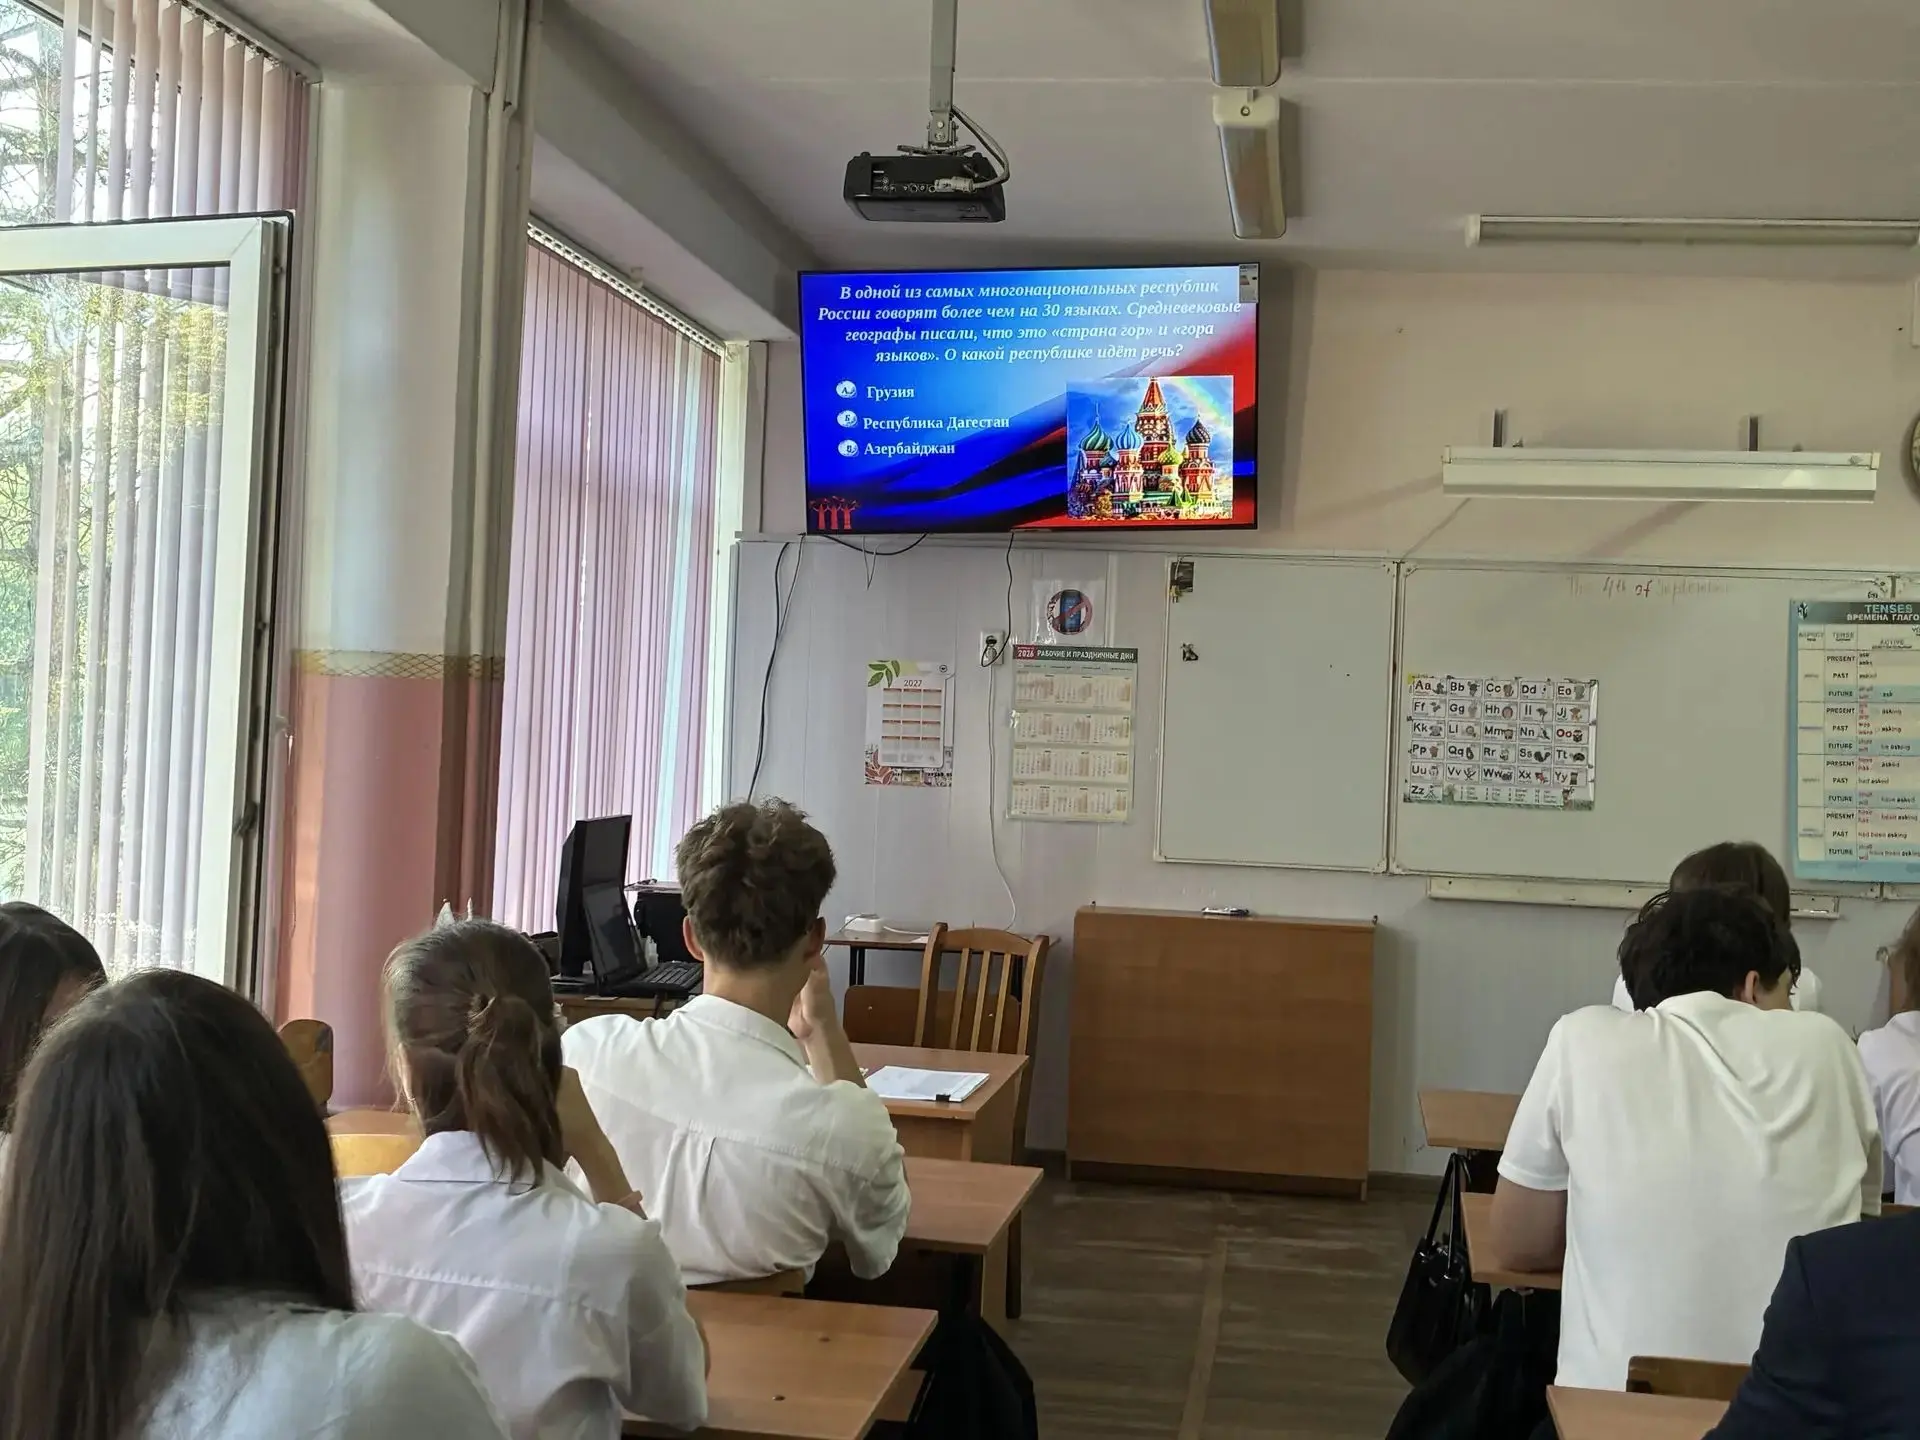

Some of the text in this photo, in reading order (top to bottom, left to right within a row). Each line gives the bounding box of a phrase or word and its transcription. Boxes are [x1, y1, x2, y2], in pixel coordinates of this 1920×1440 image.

[840, 279, 1219, 299] В одной из самых многонациональных республик
[818, 301, 1241, 322] России говорят более чем на 30 языках. Средневековые
[845, 324, 1214, 344] географы писали, что это «страна гор» и «гора
[875, 343, 1184, 363] языков». О какой республике идёт речь?
[867, 386, 915, 401] Грузия
[863, 416, 943, 432] Республика
[947, 416, 1010, 431] Дагестан
[864, 442, 955, 457] Азербайджан
[1635, 580, 1653, 598] of
[1864, 604, 1913, 614] TENSES
[1072, 651, 1119, 659] ПРАЗДНИЧНЫЕ
[1120, 652, 1134, 660] ДНИ
[1415, 680, 1431, 690] Aa
[1450, 681, 1465, 691] Bb
[1486, 683, 1501, 693] Cc
[1522, 684, 1536, 694] Dd
[1414, 702, 1426, 711] Ff
[1450, 703, 1465, 714] Gg
[1485, 704, 1500, 714] Hh
[1413, 723, 1428, 732] Kk
[1520, 727, 1535, 736] Nn
[1557, 729, 1572, 738] Oo
[1413, 744, 1567, 759] Pp Qq Rr Ss Tt
[1412, 765, 1427, 774] Uu
[1447, 767, 1461, 776] Vv
[1519, 770, 1531, 779] Xx
[1555, 771, 1568, 783] Yy
[1411, 785, 1425, 795] Zz
